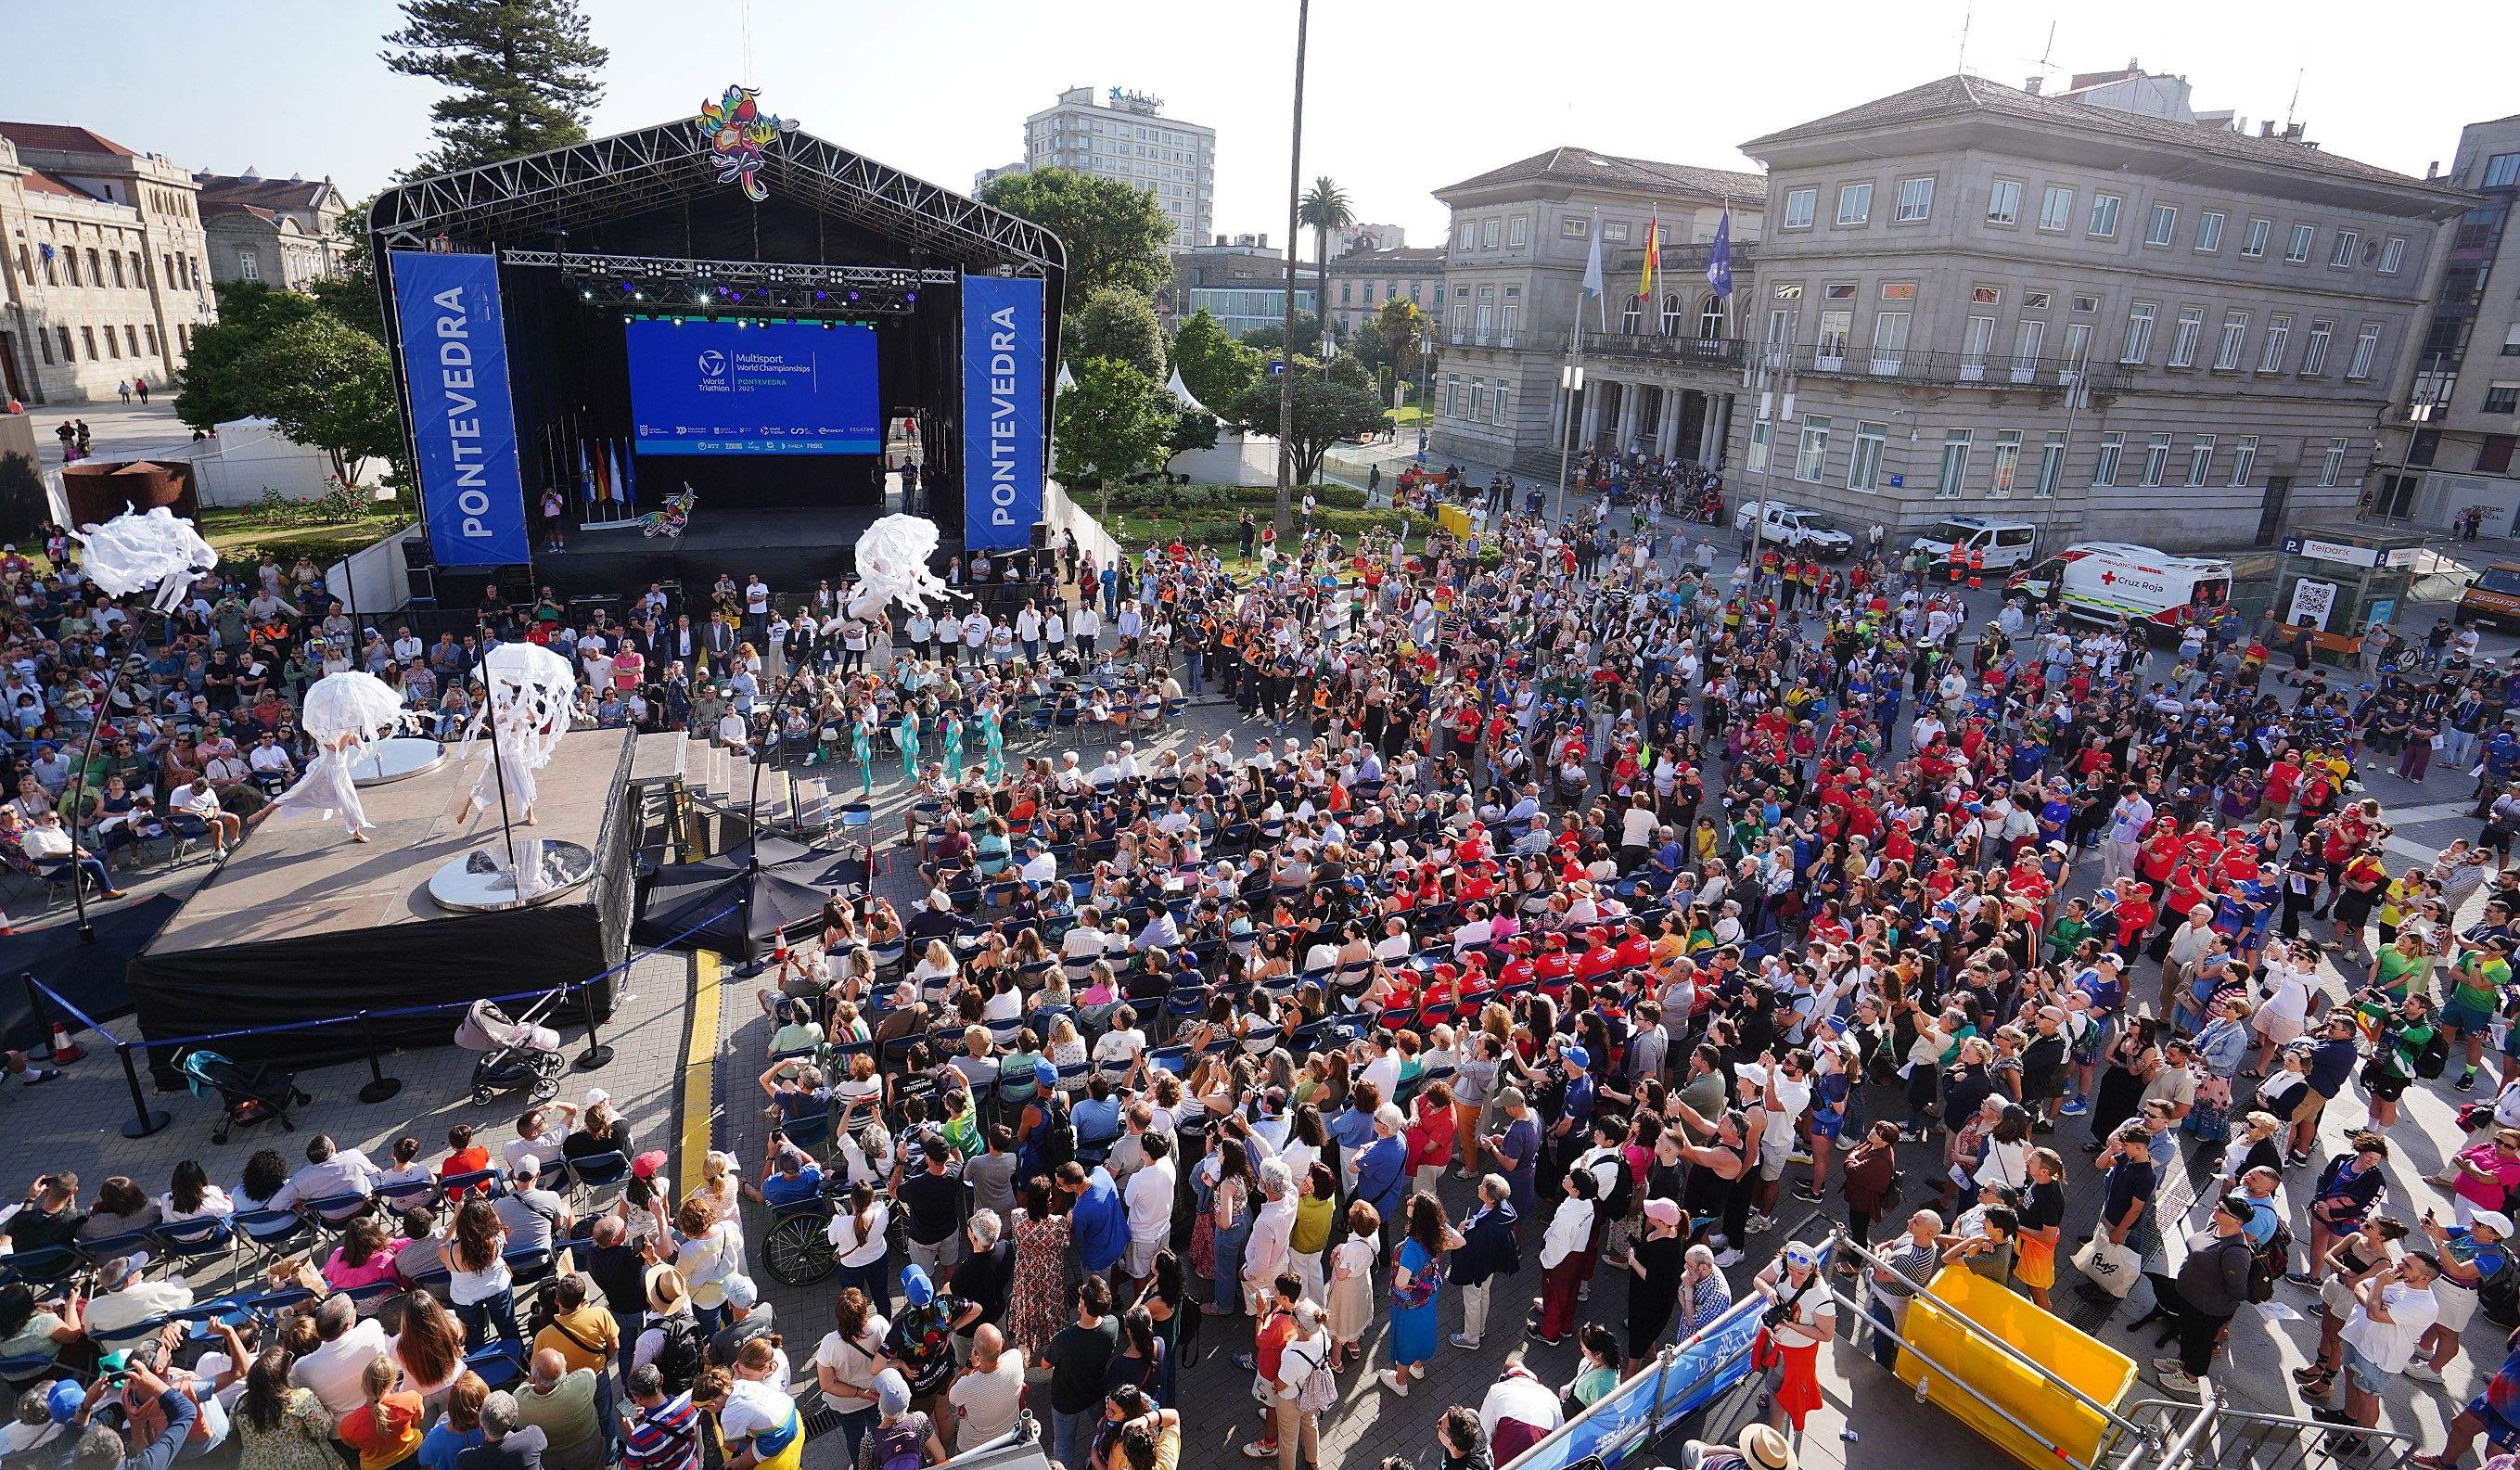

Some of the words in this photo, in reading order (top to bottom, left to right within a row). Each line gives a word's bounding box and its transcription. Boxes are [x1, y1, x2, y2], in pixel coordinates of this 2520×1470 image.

[736, 353, 784, 364] Multisport
[759, 364, 811, 373] Championships
[698, 384, 730, 392] Triathlon
[433, 286, 493, 538] PONTEVEDRA
[991, 306, 1016, 526] PONTEVEDRA
[2285, 540, 2297, 551] P
[2311, 543, 2350, 557] telpark
[2098, 557, 2138, 569] AMBULANCIA
[2377, 554, 2385, 565] P
[2117, 576, 2140, 588] Cruz
[2142, 582, 2164, 593] Roja
[902, 1080, 933, 1093] TRIOMPHE
[2361, 1184, 2386, 1214] USA
